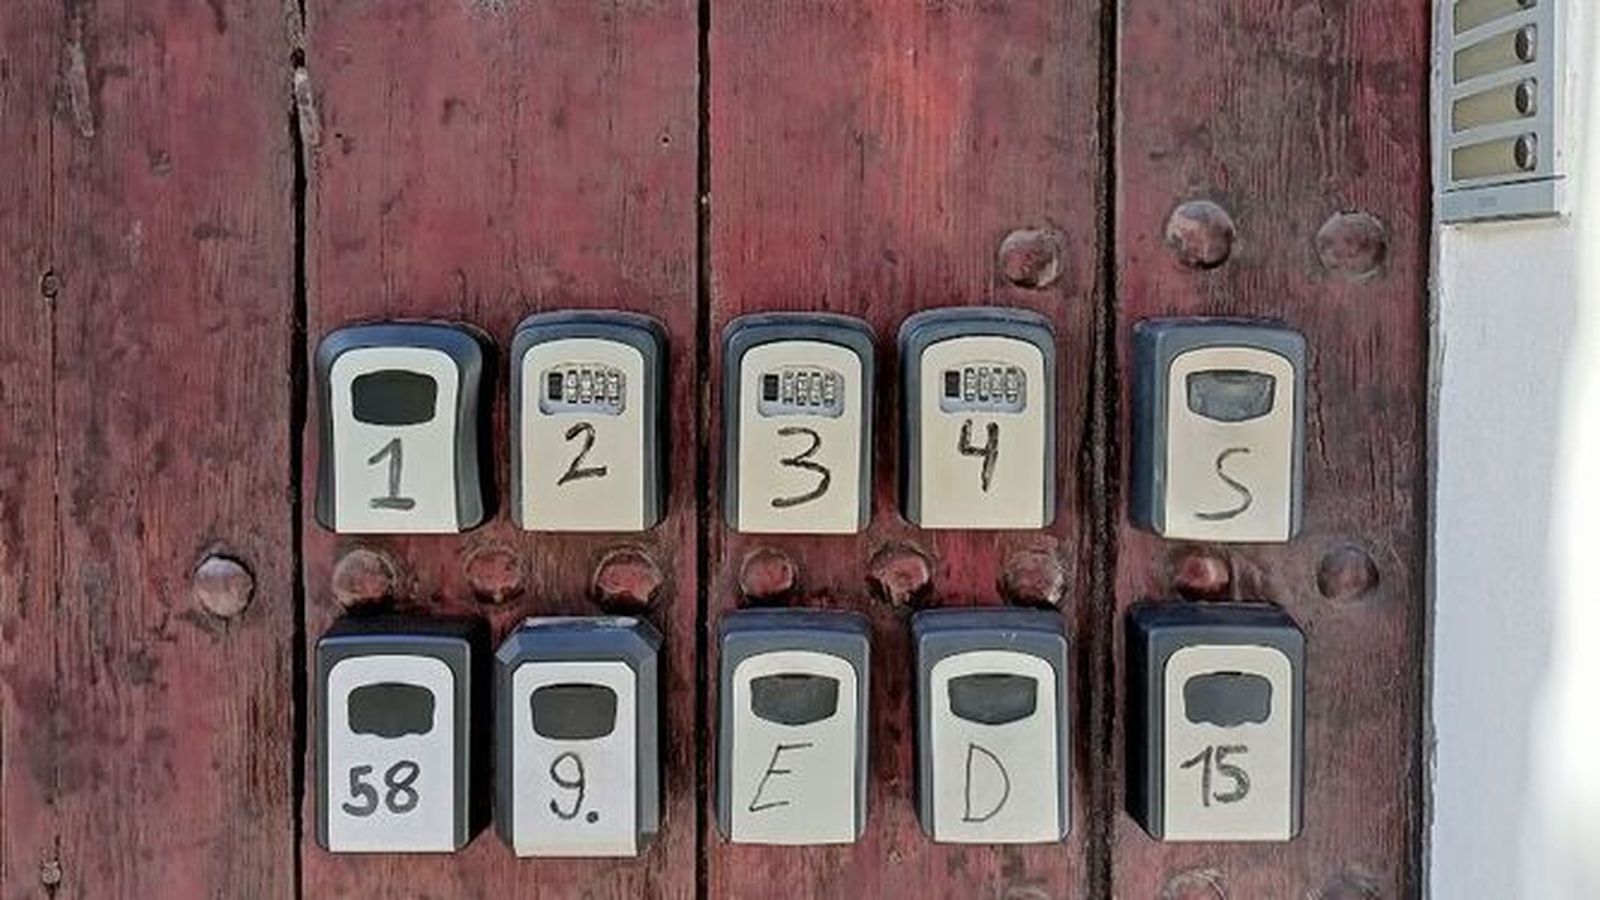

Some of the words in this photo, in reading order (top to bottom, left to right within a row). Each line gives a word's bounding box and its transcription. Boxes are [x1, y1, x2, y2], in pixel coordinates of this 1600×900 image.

[367, 437, 417, 512] 1
[556, 421, 608, 487] 2
[770, 426, 832, 509] 3
[957, 418, 1000, 493] 4
[1195, 447, 1253, 521] S
[341, 759, 421, 818] 58
[748, 742, 814, 813] E
[961, 742, 1011, 823] D
[1179, 744, 1251, 808] 15
